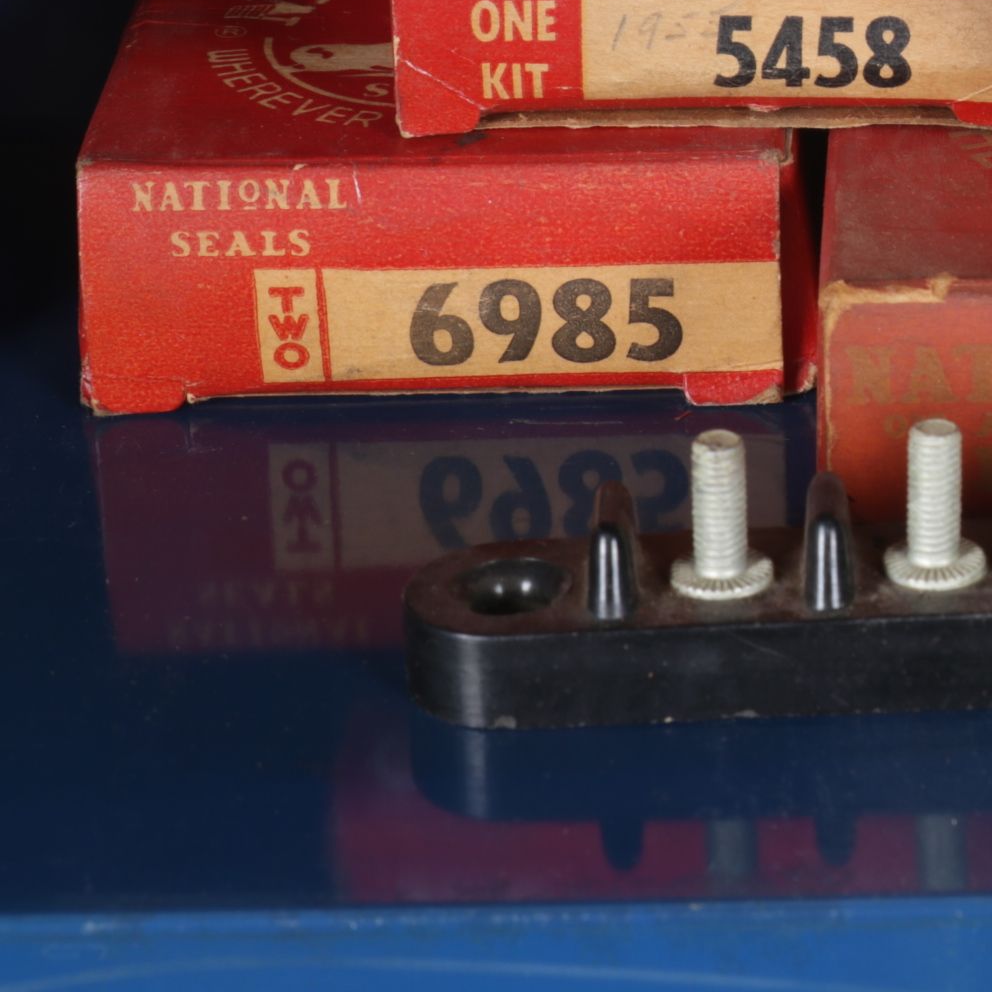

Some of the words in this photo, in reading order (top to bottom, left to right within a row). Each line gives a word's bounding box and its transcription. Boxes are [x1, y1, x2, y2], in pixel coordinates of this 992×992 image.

[471, 0, 556, 42] ONE
[713, 15, 912, 88] 5458
[206, 48, 384, 128] WHEREVER
[482, 63, 549, 99] KIT
[130, 178, 348, 213] NATIONAL
[170, 230, 312, 257] SEALS
[268, 286, 311, 372] TWO
[409, 277, 684, 367] 6985
